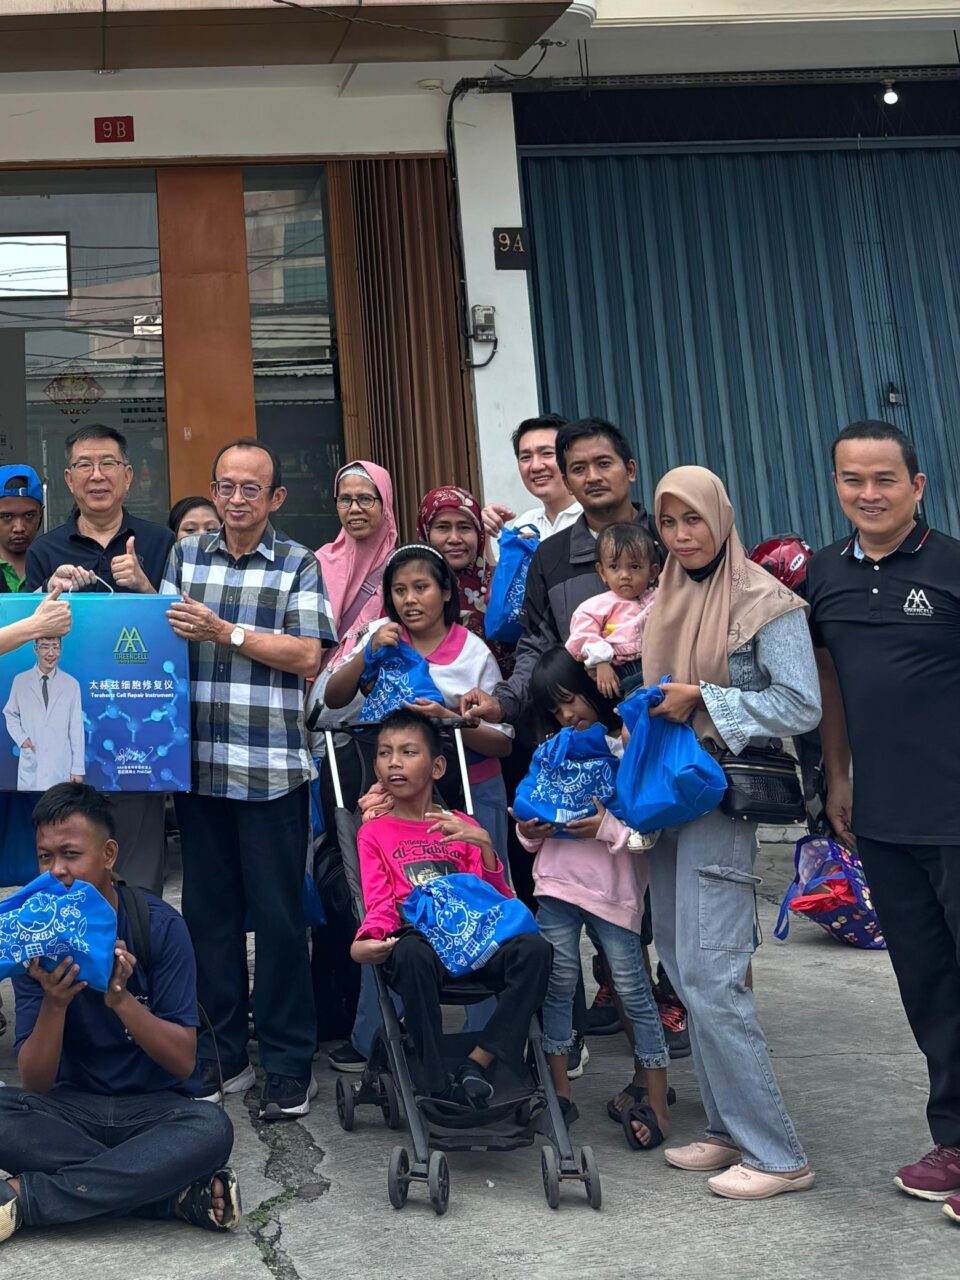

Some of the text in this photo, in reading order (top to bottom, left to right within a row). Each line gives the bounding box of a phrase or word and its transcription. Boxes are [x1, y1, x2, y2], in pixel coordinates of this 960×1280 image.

[102, 121, 127, 138] 9B
[498, 232, 525, 252] 9A
[89, 679, 174, 690] 太赫兹细胞修复仪
[563, 781, 583, 794] GREEN
[20, 926, 55, 943] GO GREEN
[461, 919, 478, 942] GREEN
